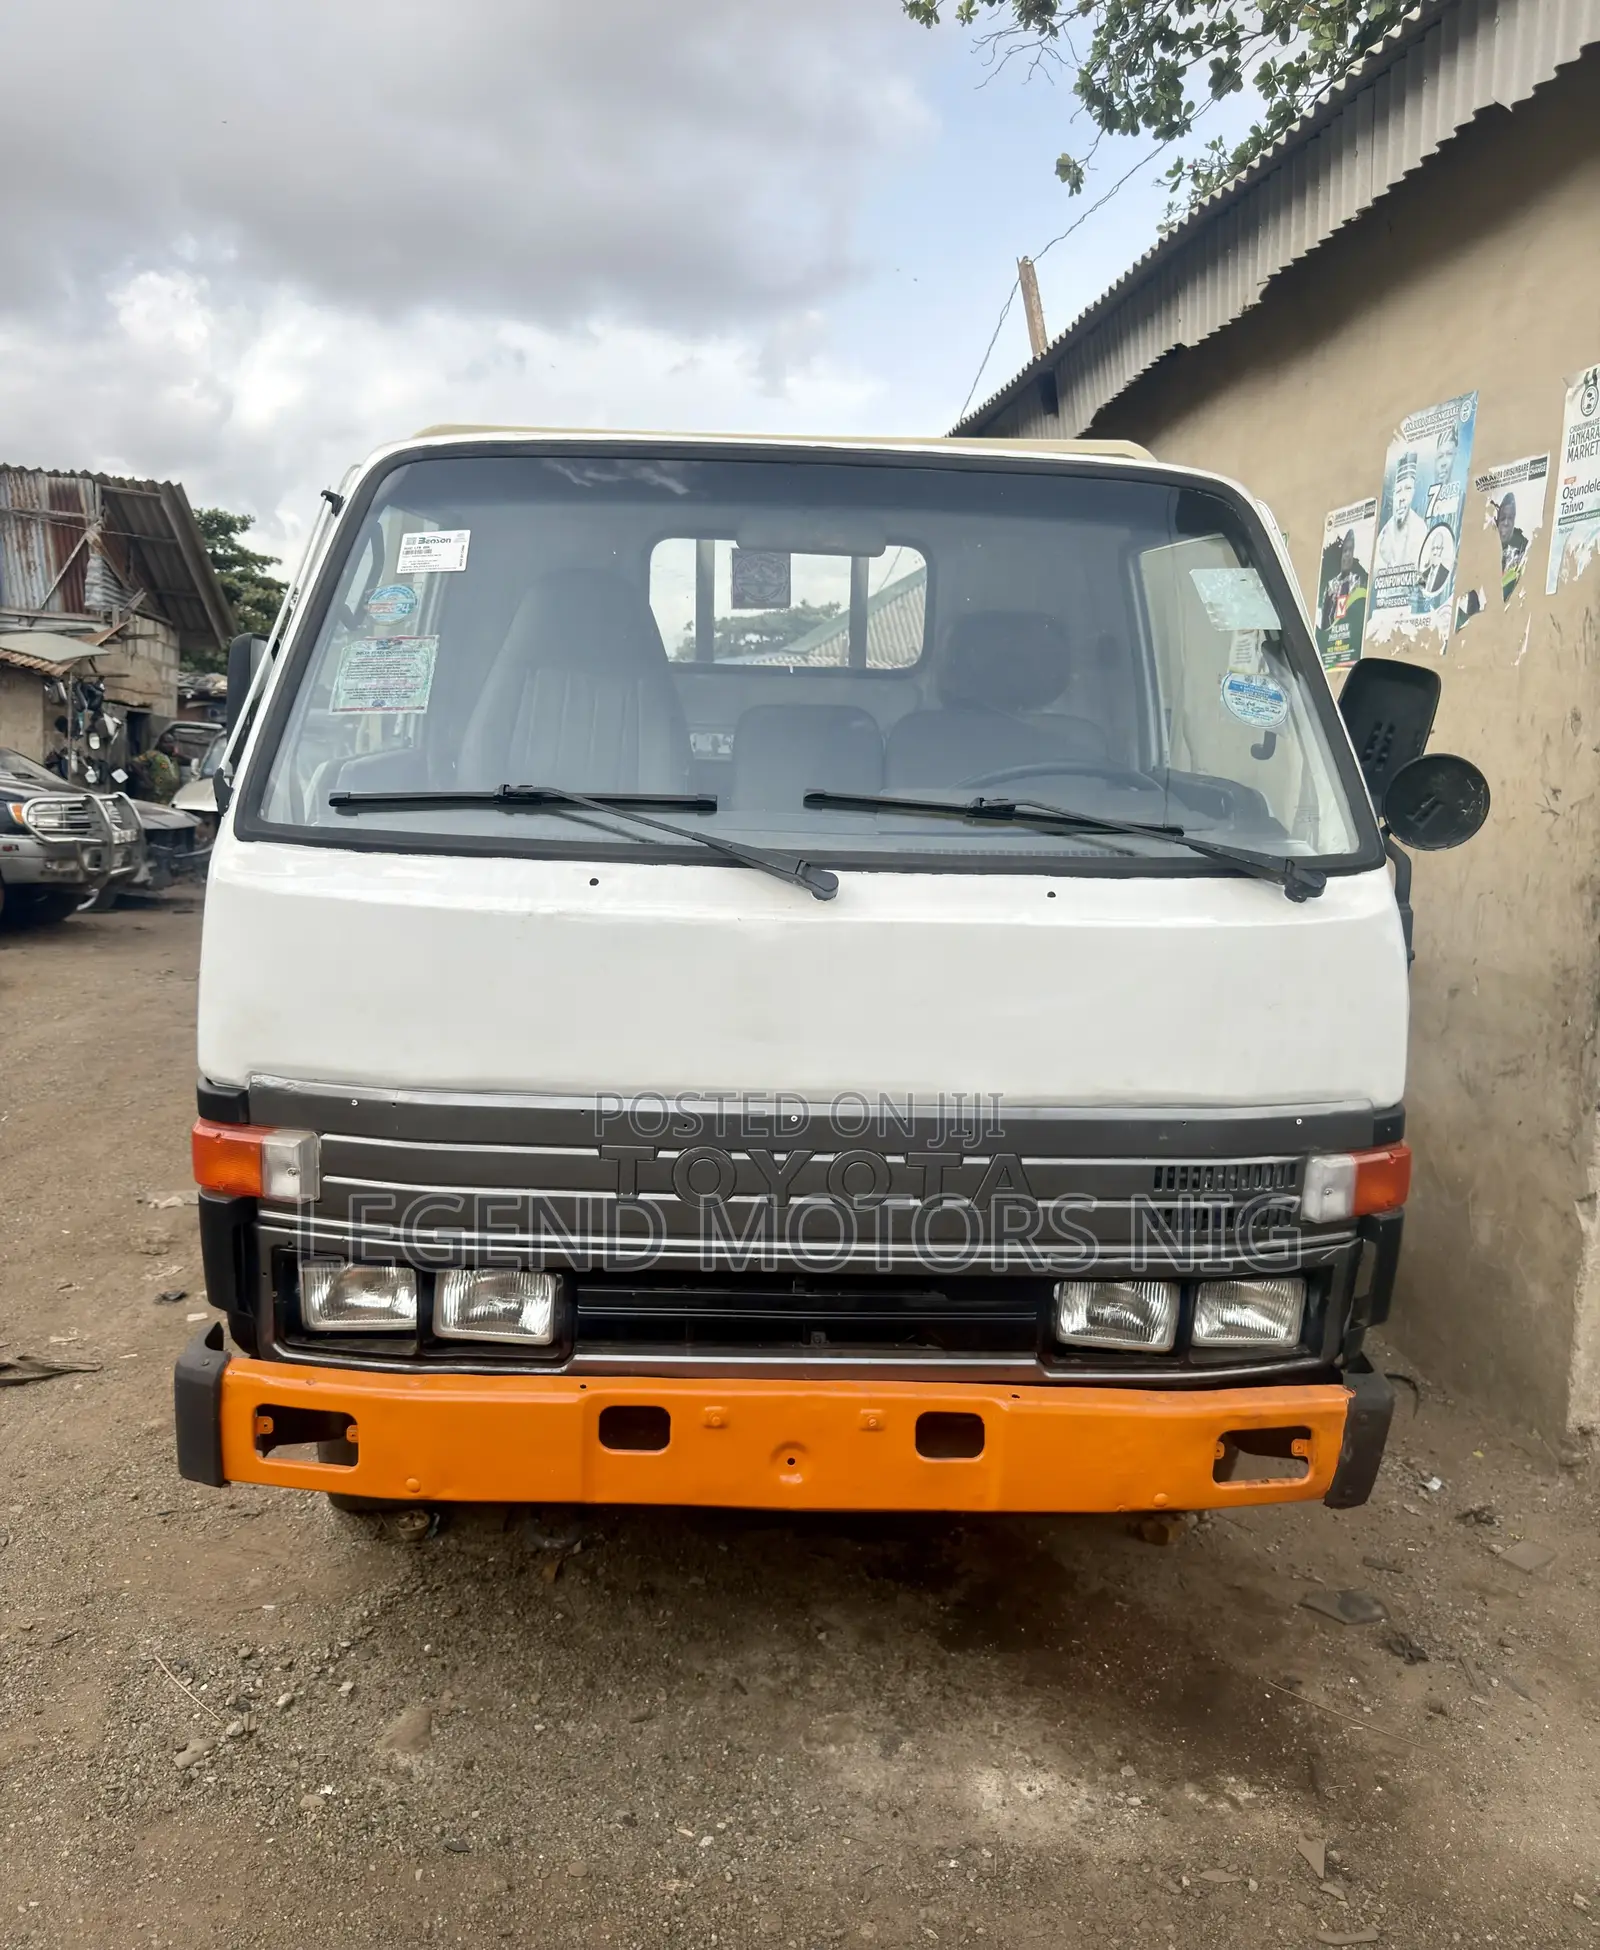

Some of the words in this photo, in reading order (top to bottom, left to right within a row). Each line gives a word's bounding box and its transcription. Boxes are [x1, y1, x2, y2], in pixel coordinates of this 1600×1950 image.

[1568, 426, 1600, 447] JANKARA
[1566, 440, 1600, 463] MARKET
[1561, 501, 1584, 515] Taiwo
[417, 535, 452, 545] Benson
[600, 1145, 1038, 1212] TOYOTA
